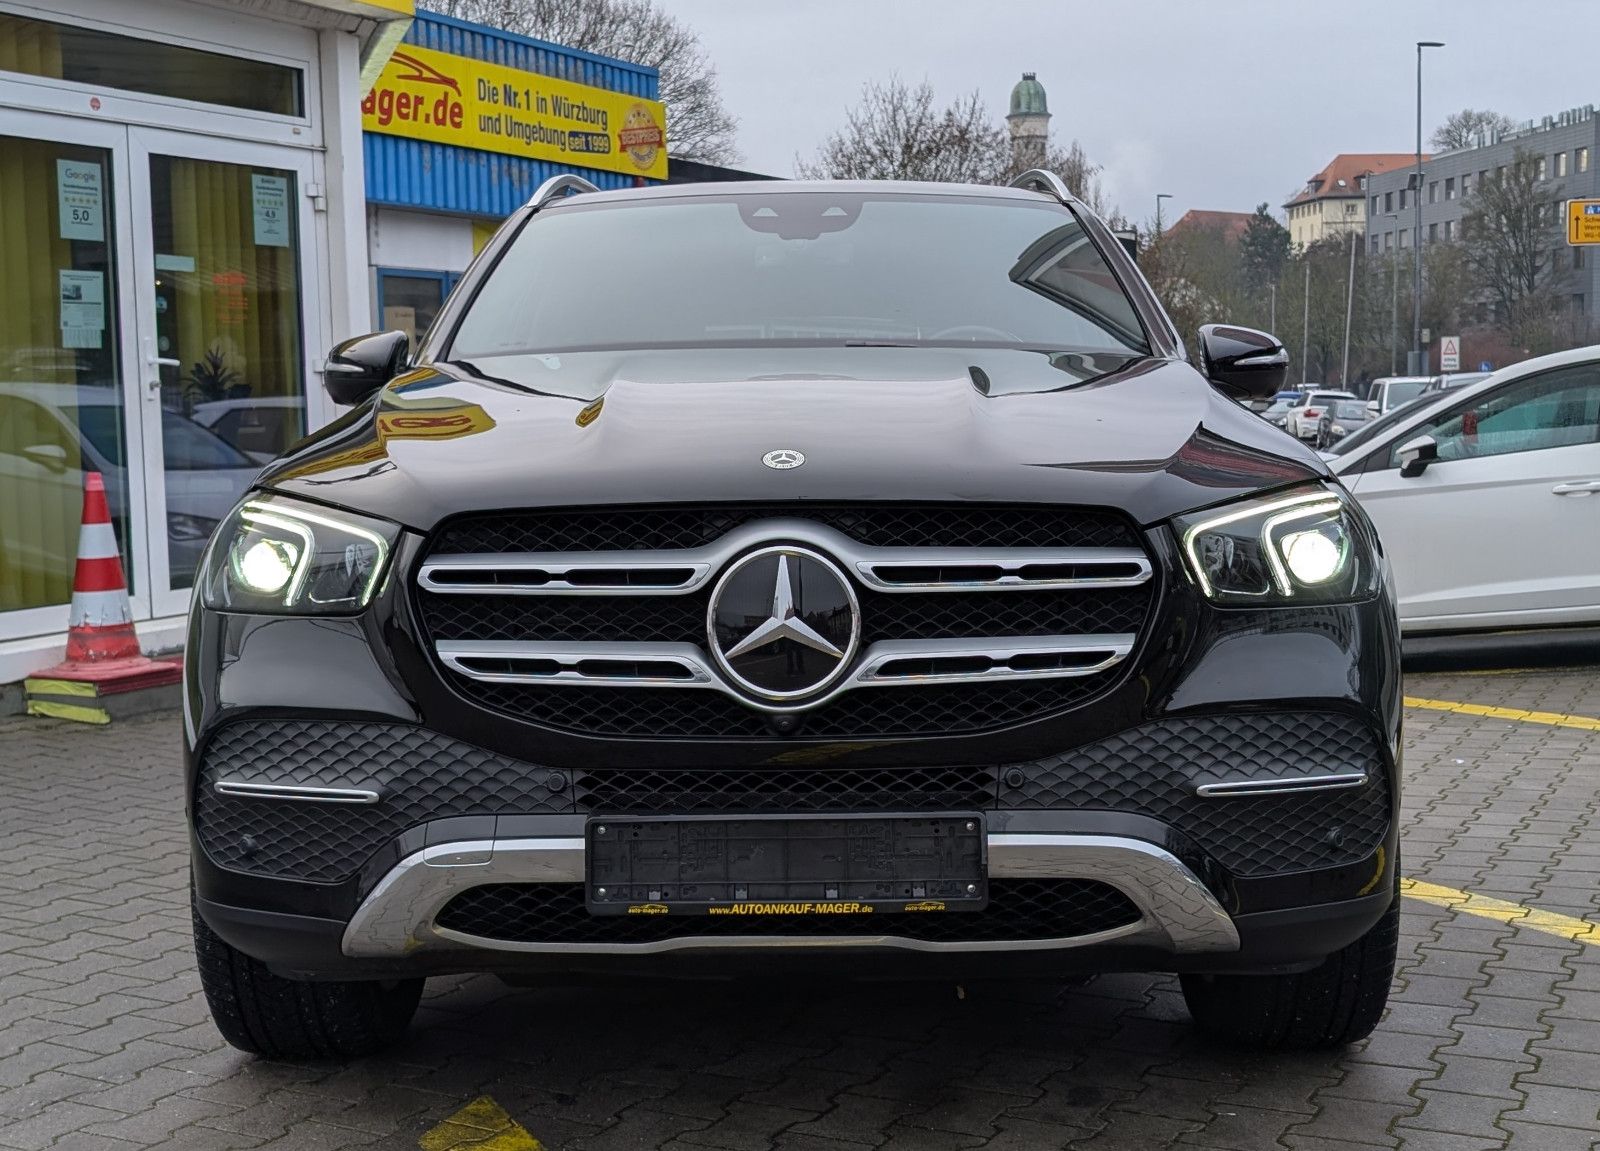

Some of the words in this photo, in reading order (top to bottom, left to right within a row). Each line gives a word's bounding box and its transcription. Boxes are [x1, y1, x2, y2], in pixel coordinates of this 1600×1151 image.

[477, 78, 499, 104] Die
[503, 84, 521, 109] Nr.
[525, 89, 531, 111] 1
[536, 91, 548, 115] in
[551, 94, 608, 131] Würzburg
[479, 113, 501, 135] und
[505, 115, 567, 152] Umgebung
[568, 135, 586, 149] seit
[587, 138, 610, 152] 1999
[65, 168, 97, 184] Google
[72, 208, 90, 222] 5,0
[709, 903, 874, 915] www.AUTOANKAUF-MAGER.de
